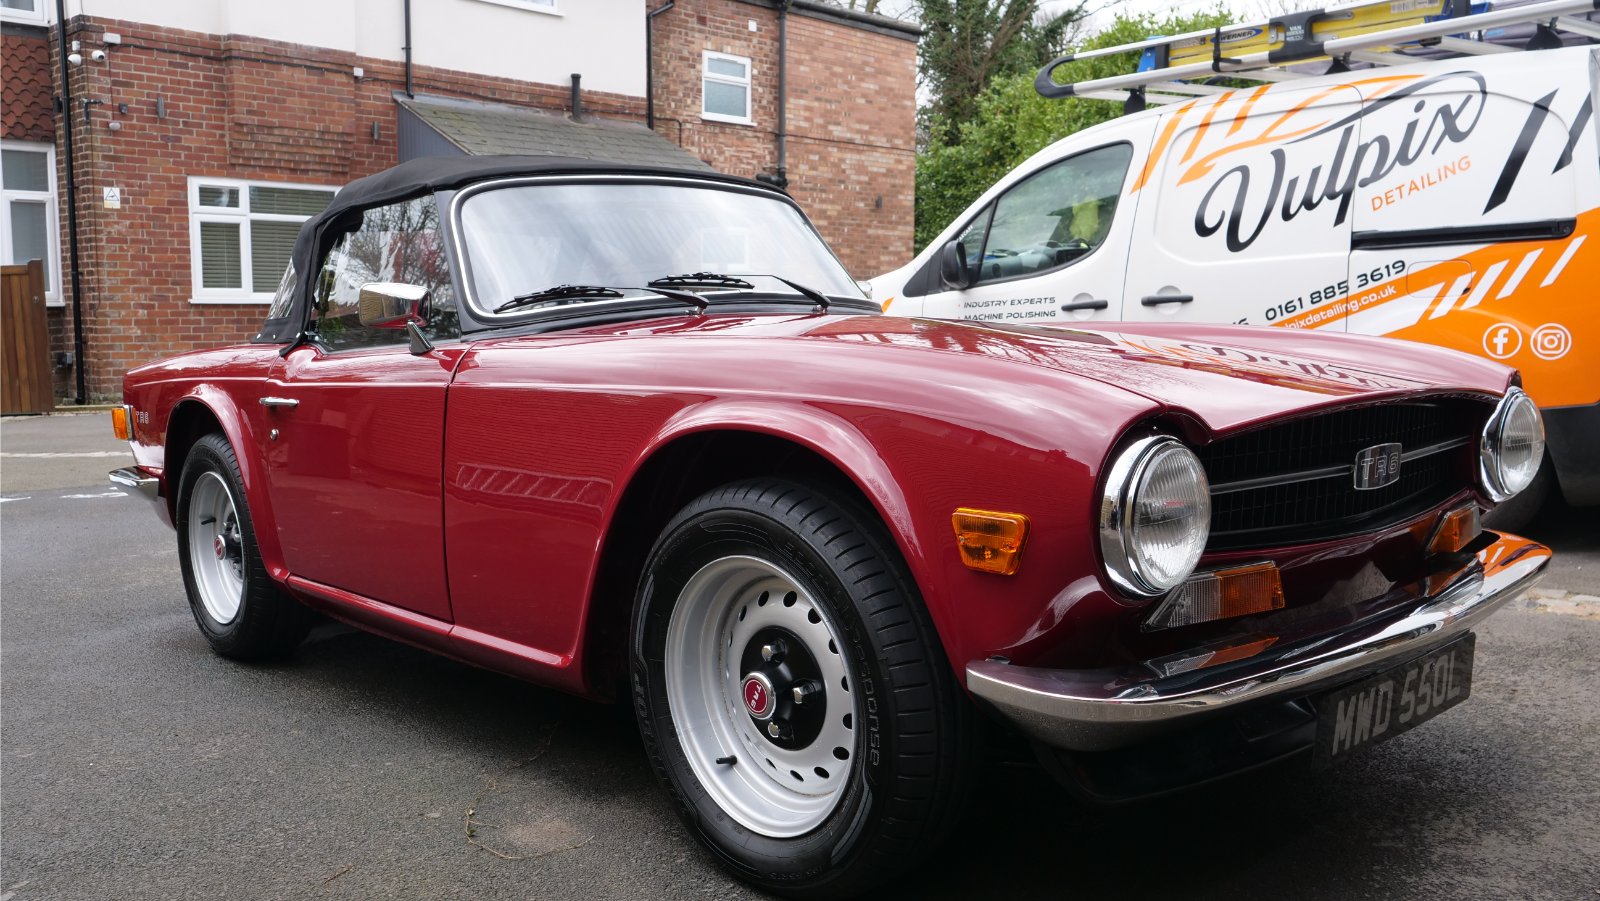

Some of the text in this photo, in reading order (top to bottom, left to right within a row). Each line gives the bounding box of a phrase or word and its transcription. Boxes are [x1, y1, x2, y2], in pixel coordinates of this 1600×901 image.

[1221, 30, 1254, 41] WERNER
[1195, 71, 1486, 252] Vulpix
[1371, 156, 1471, 211] DETAILING
[963, 297, 1056, 308] INDUSTRY EXPERTS
[1266, 260, 1406, 321] 0161 885 3619
[963, 310, 1056, 320] MACHINE POLISHING
[1361, 452, 1399, 479] TR6
[750, 684, 762, 709] TR6
[1331, 651, 1461, 756] MWD 550L
